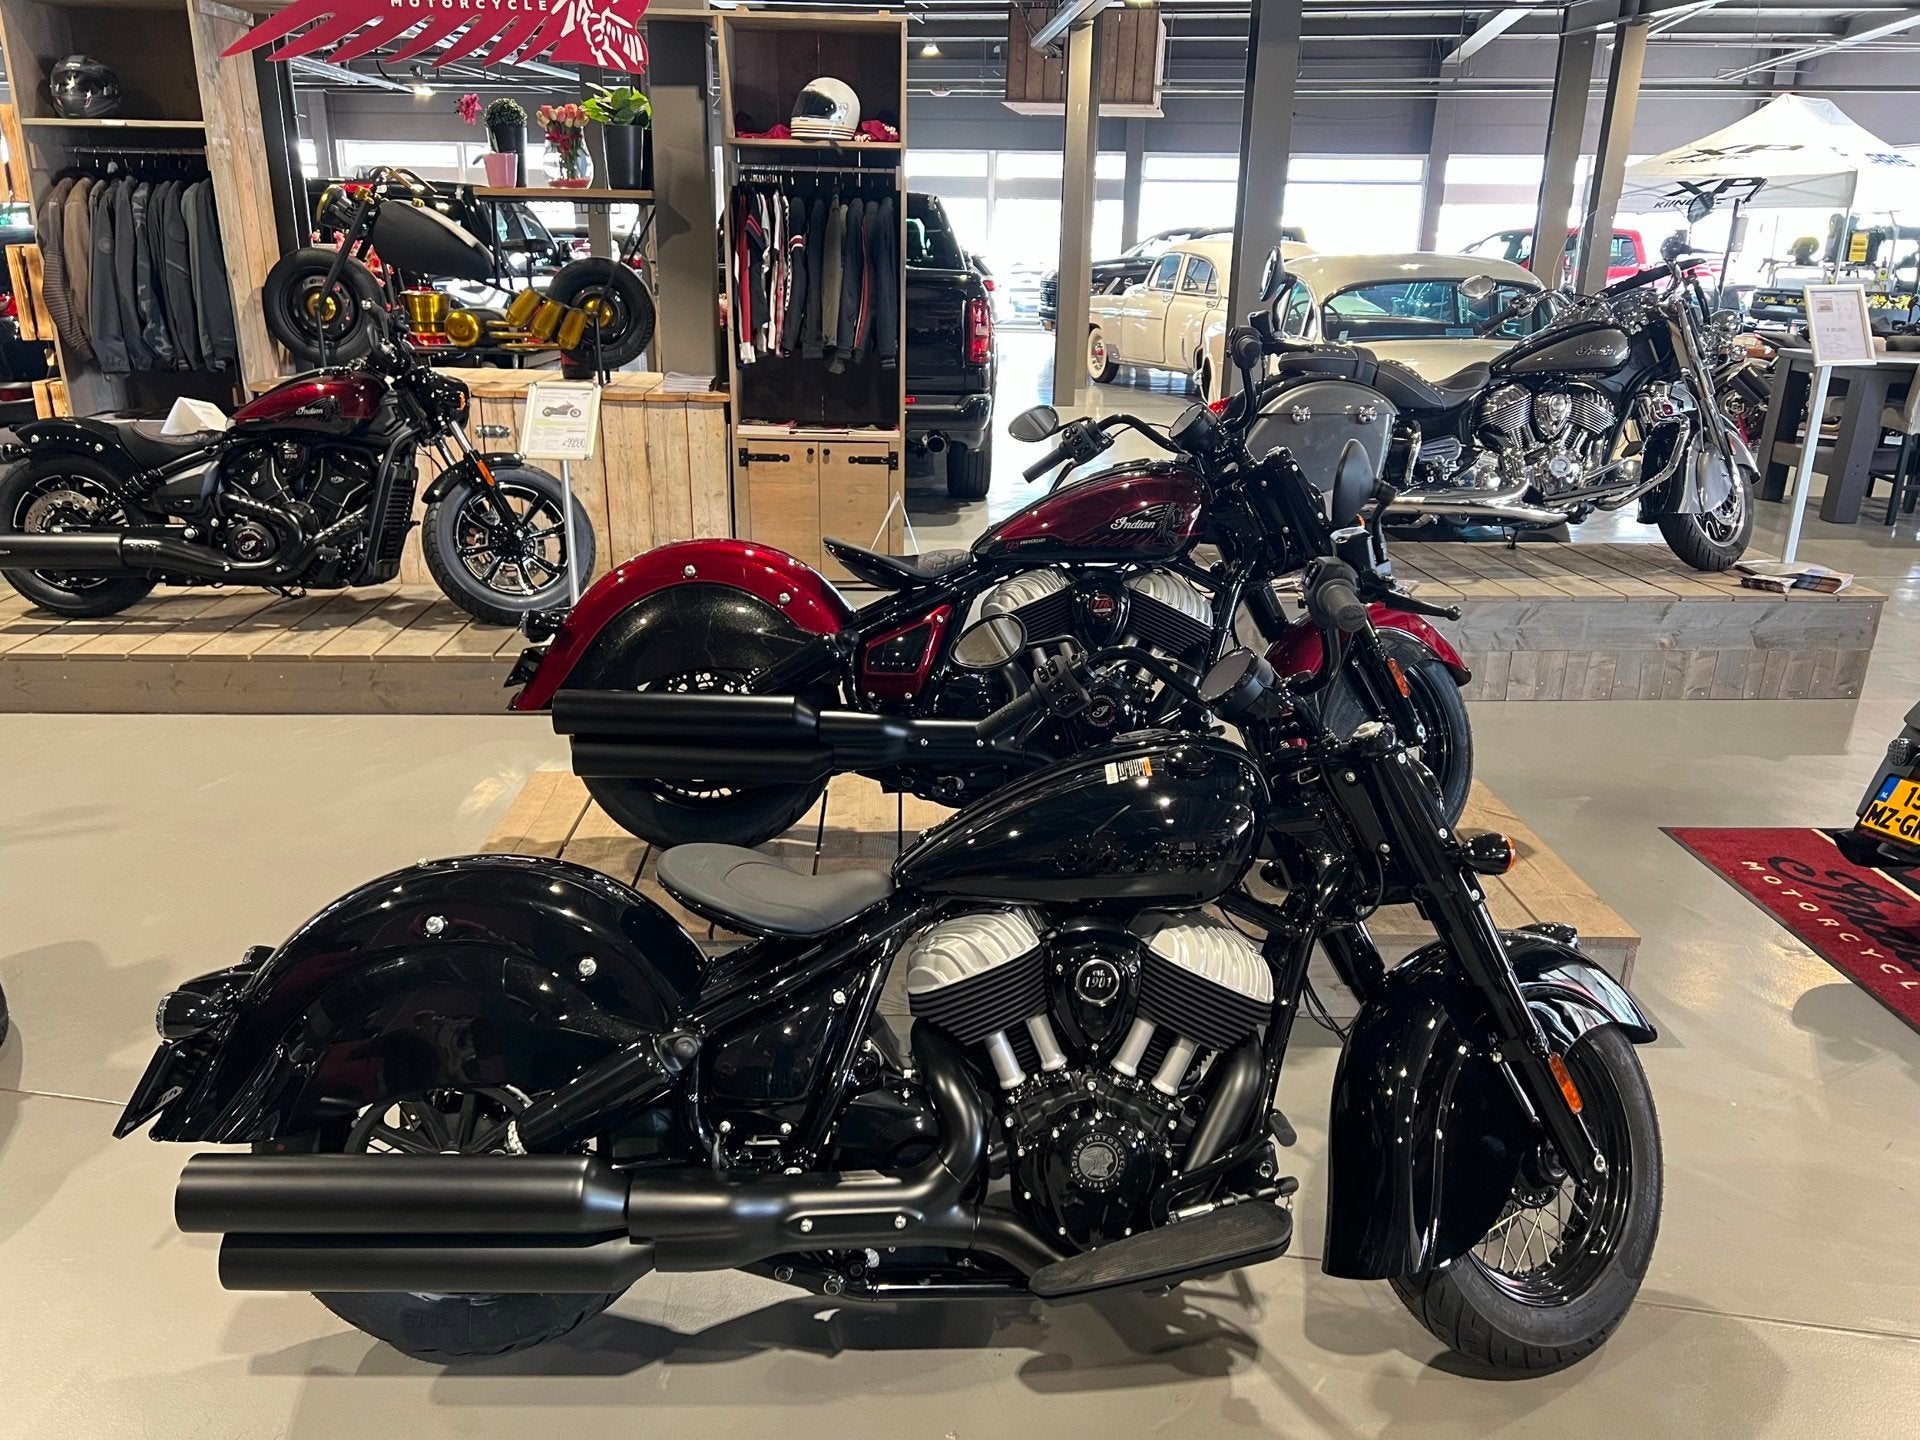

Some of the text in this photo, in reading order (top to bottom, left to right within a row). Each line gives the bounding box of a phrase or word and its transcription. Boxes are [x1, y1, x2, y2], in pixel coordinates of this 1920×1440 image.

[390, 0, 548, 11] MOTORCYCLE
[295, 406, 323, 416] Indian
[1110, 516, 1156, 531] Indian
[1880, 791, 1889, 799] NL
[1085, 976, 1112, 988] 1901
[1072, 1135, 1125, 1178] INDIAN MOTORCYCLE
